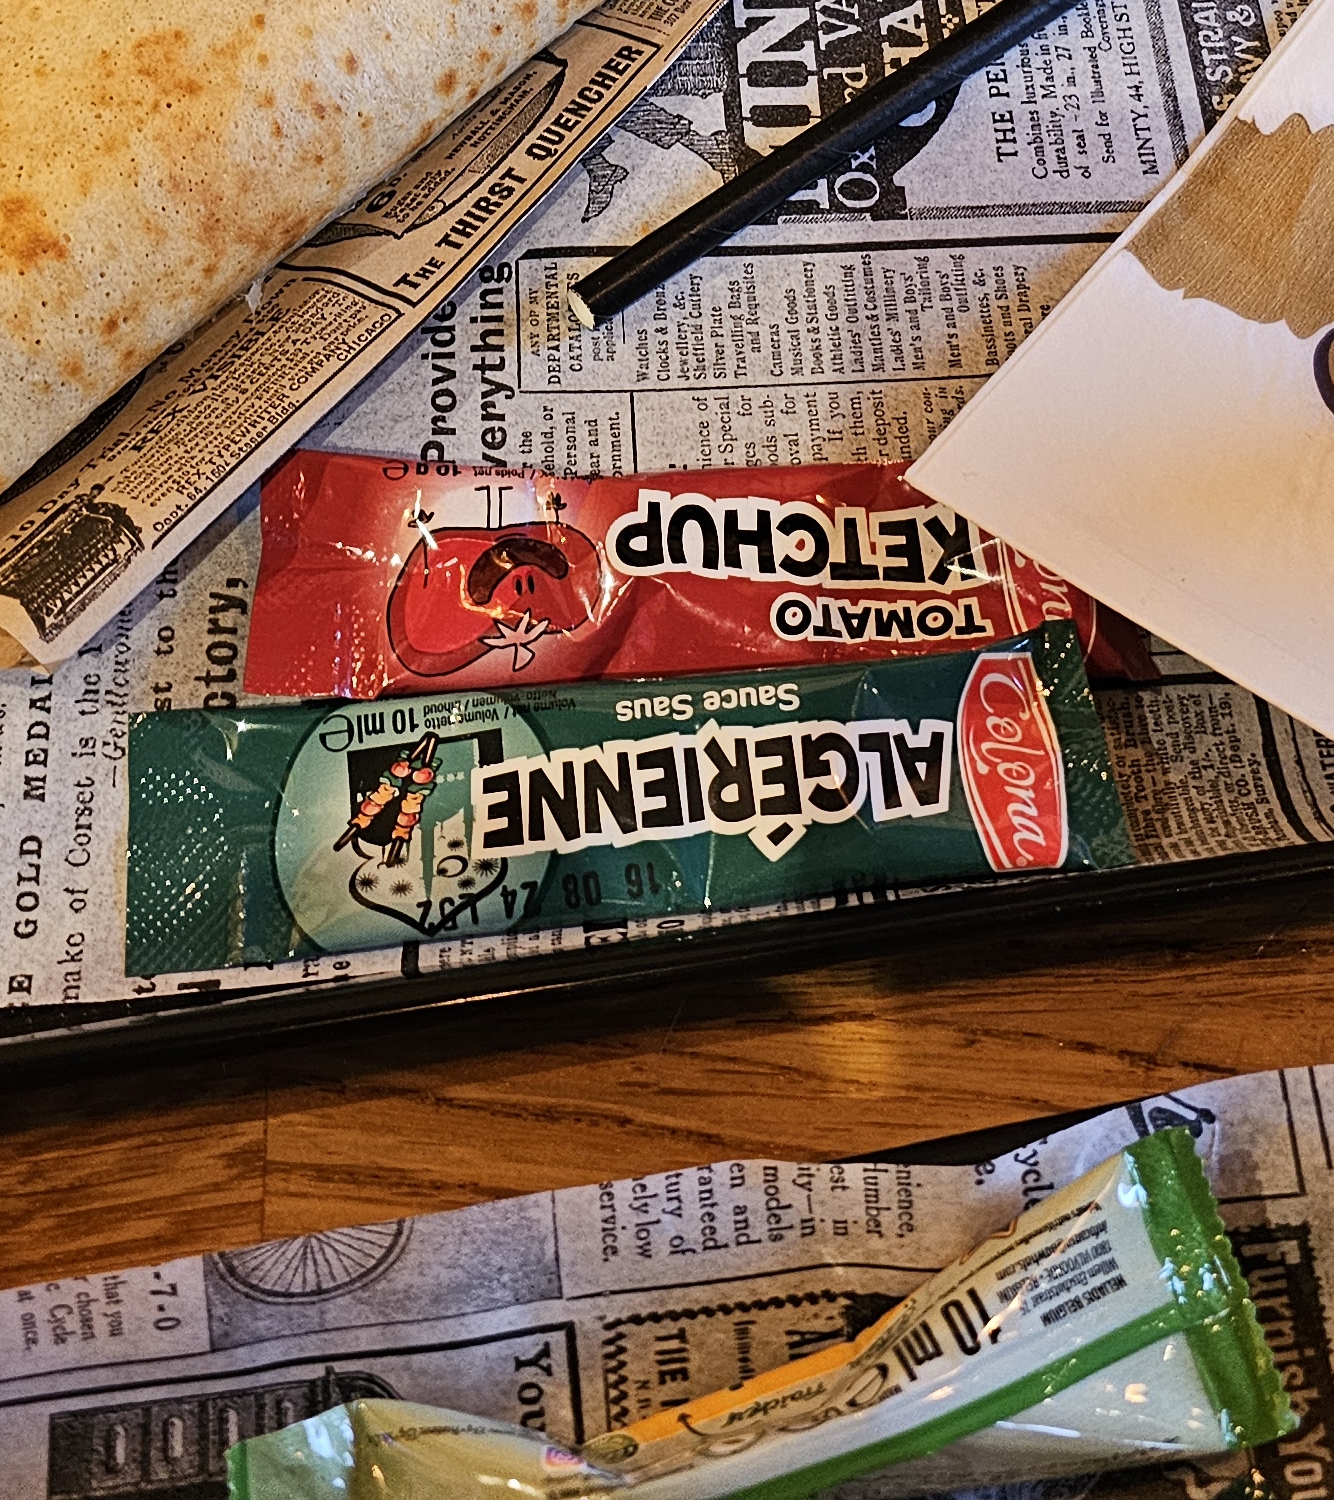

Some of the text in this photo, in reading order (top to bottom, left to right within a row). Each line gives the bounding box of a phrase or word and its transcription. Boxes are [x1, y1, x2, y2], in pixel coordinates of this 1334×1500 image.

[1017, 42, 1037, 104] luxurious
[1116, 27, 1140, 76] HIGH
[438, 166, 525, 253] THIRST
[525, 44, 643, 162] QUENCHER
[991, 110, 1018, 161] THE
[1028, 110, 1047, 178] Combines
[1040, 59, 1069, 178] durability. Made
[1099, 132, 1115, 163] Send
[528, 310, 540, 326] OF
[543, 261, 561, 384] DEPARTMENTAL
[688, 273, 707, 379] Sheffield Cutlery
[742, 262, 760, 325] Requisites
[801, 260, 824, 373] Books Stationery
[335, 309, 393, 365] CHICAGO
[529, 330, 540, 356] ANY
[635, 328, 650, 380] Watches
[656, 340, 670, 380] Clocks
[672, 290, 690, 380] Jewellery, &c.
[709, 305, 726, 378] Silver Plate
[729, 314, 747, 378] Travelling
[769, 323, 783, 376] Cameras
[783, 288, 803, 376] Musical Goods
[823, 284, 844, 373] Athletic Goods
[131, 309, 286, 456] REX VISIBLE
[175, 334, 349, 497] REX TYPEWRITER COMPANY
[418, 300, 457, 463] Provide
[714, 396, 733, 452] Special
[803, 392, 827, 460] payment
[612, 496, 972, 586] KETCHUP
[773, 597, 990, 640] TOMATO
[389, 705, 420, 735] 10
[617, 682, 798, 721] Sauce Saus
[482, 728, 954, 850] ALGÉRIENNE
[979, 668, 1045, 864] Colona
[1247, 752, 1269, 804] Surrey.
[66, 774, 97, 867] Corset
[10, 833, 45, 940] GOLD
[500, 862, 660, 916] 16 08 24
[598, 1180, 621, 1264] service.
[732, 1205, 761, 1247] and
[763, 1165, 784, 1244] models
[635, 1226, 653, 1261] low
[894, 1286, 1002, 1382] 10 ml
